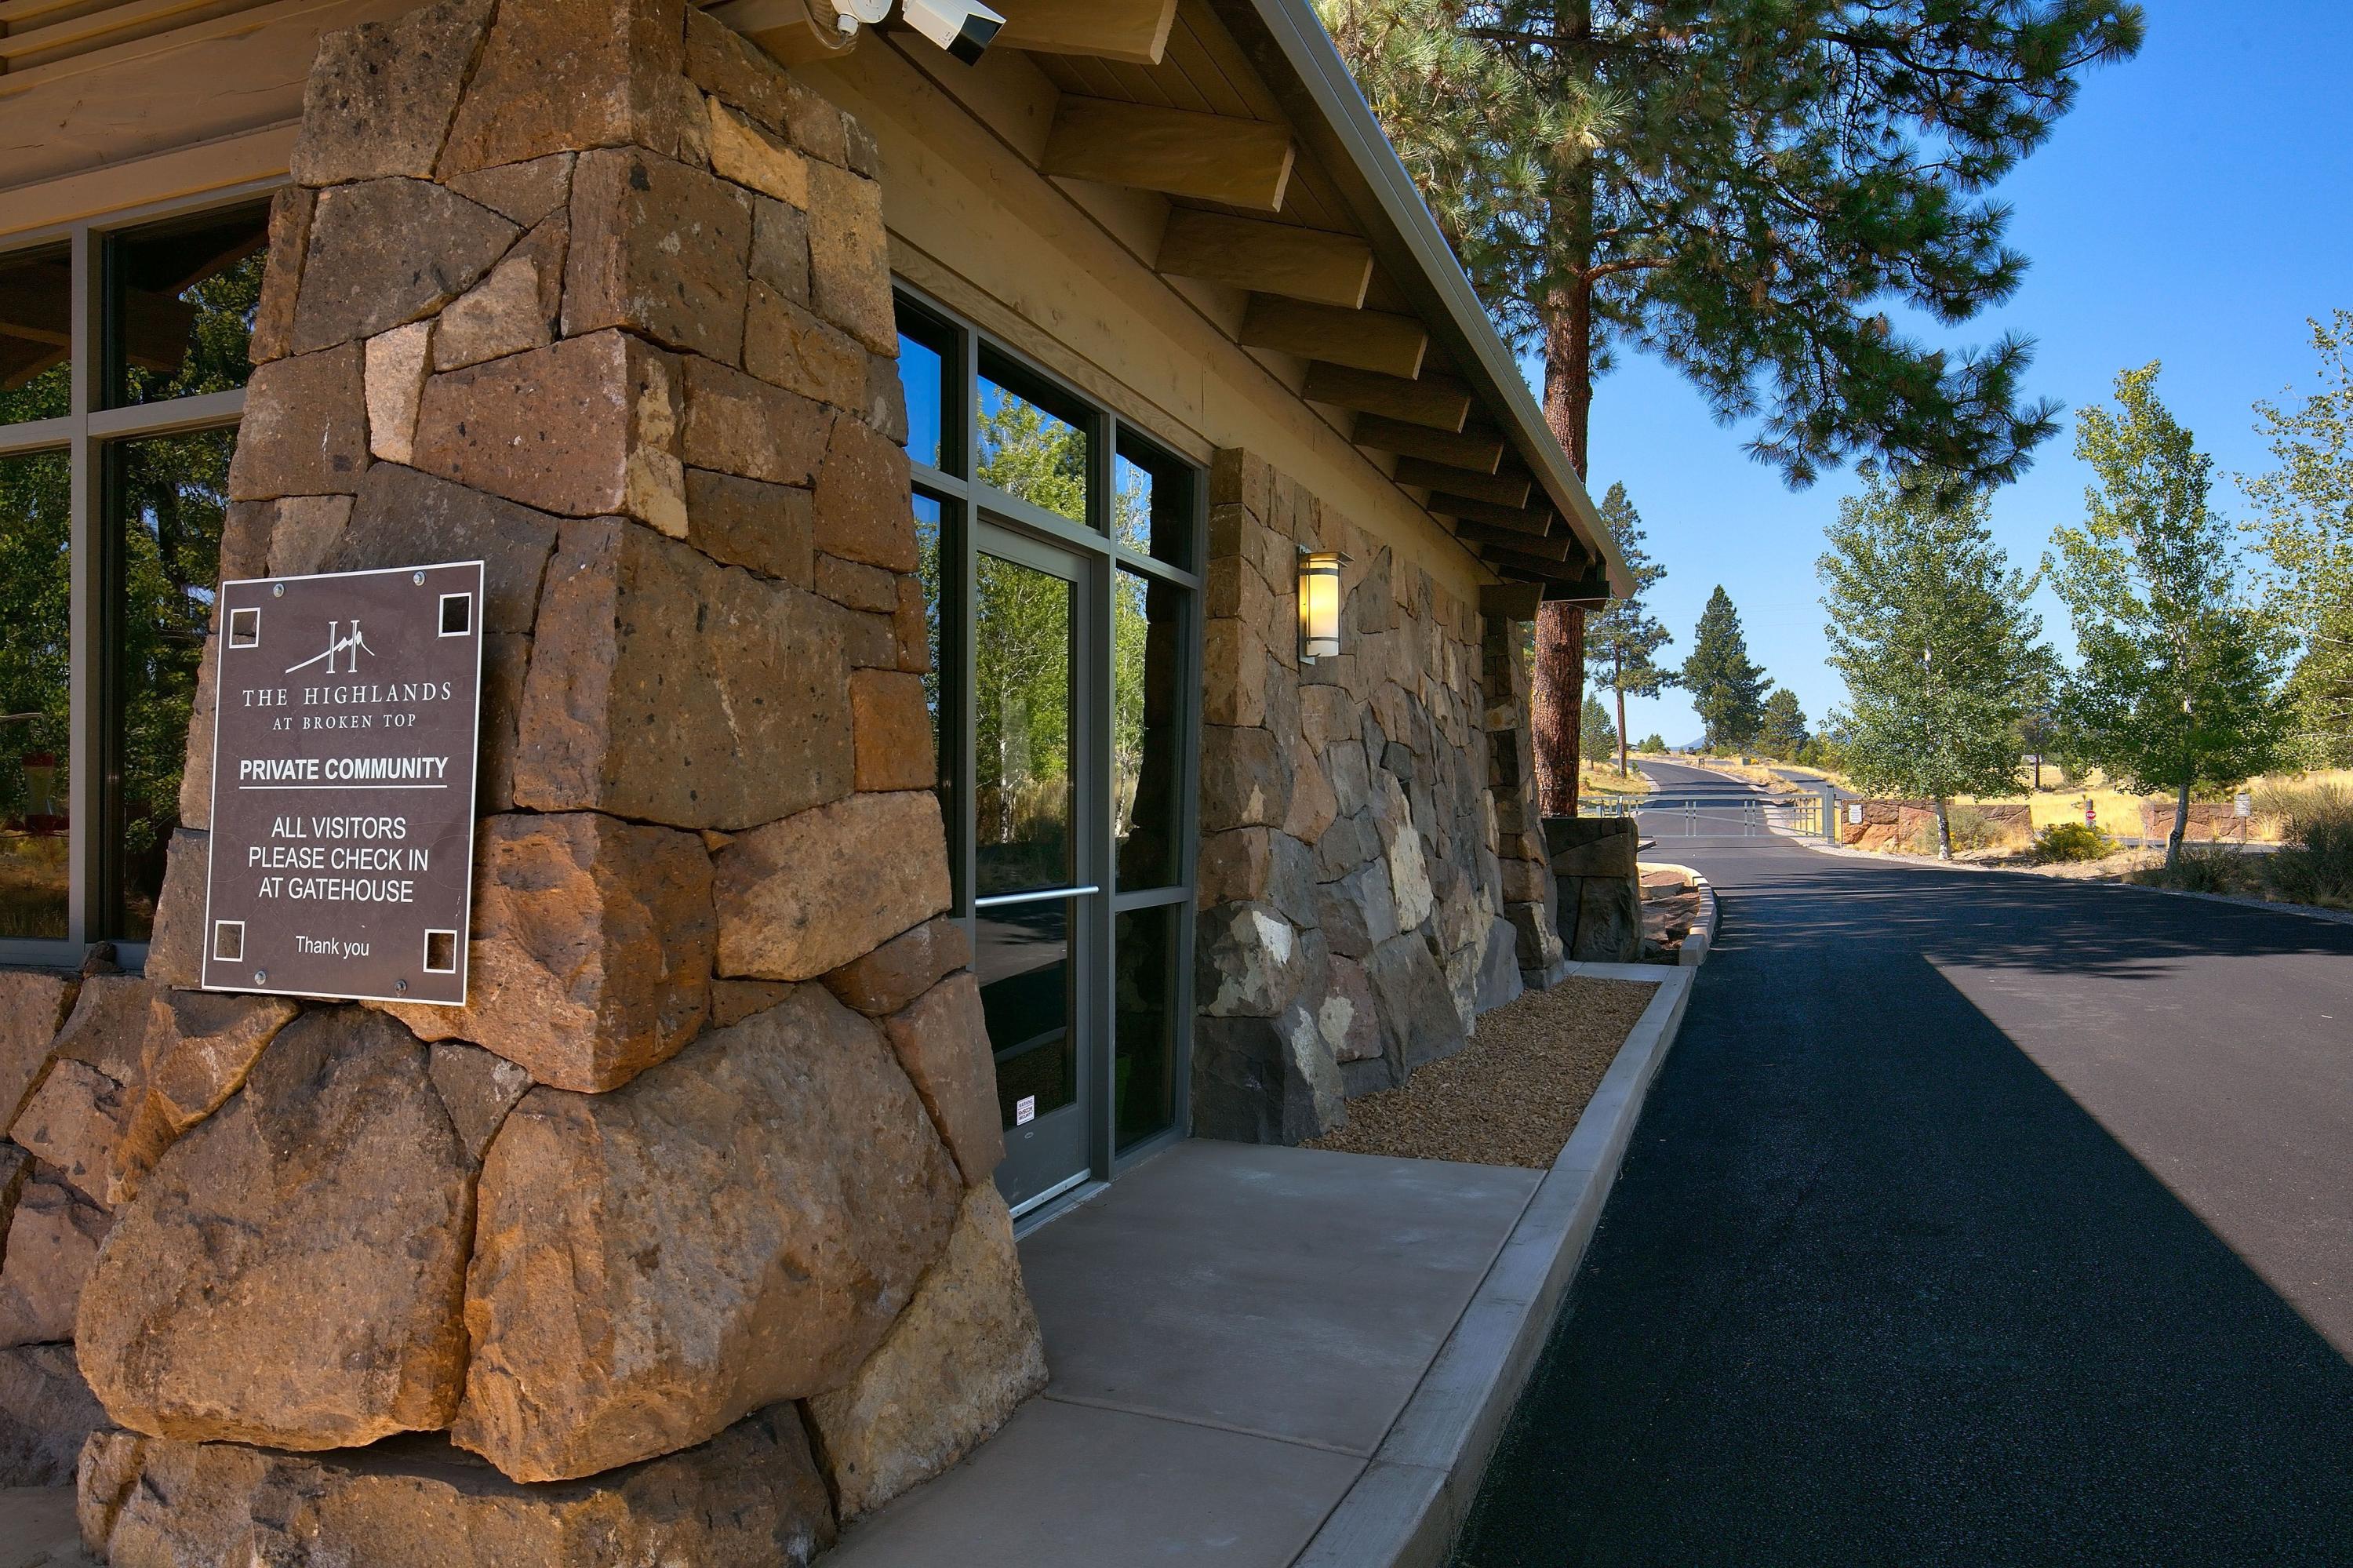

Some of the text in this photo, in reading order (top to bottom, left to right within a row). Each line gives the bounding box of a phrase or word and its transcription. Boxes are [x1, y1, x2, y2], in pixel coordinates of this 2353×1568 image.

[242, 682, 452, 707] THE HIGHLANDS
[272, 713, 416, 730] AT BROKEN TOP
[239, 756, 449, 780] PRIVATE COMMUNITY
[271, 817, 406, 840] ALL VISITORS
[249, 846, 429, 871] PLEASE CHECK IN
[258, 876, 414, 903] AT GATEHOUSE
[295, 935, 369, 960] Thank you
[1018, 1098, 1033, 1108] WARNING
